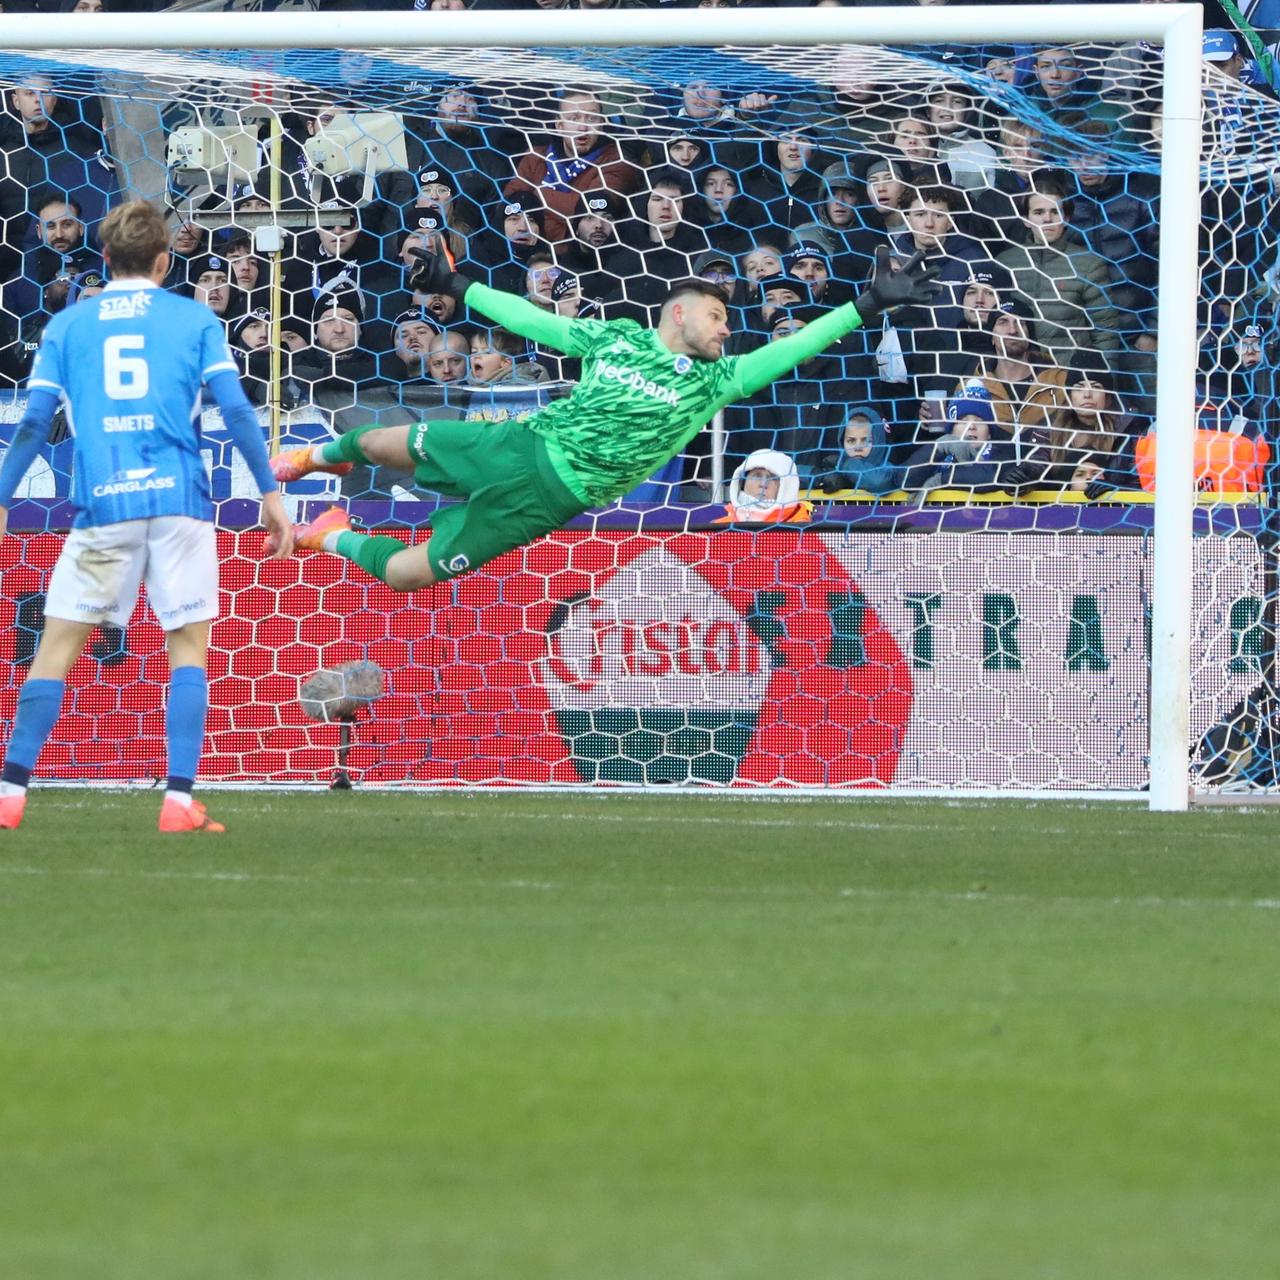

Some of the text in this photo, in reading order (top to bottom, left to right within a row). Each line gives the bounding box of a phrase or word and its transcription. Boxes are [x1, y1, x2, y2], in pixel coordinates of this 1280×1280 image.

[99, 293, 149, 314] STAR
[103, 335, 150, 401] 6
[103, 415, 155, 433] SMETS
[93, 475, 176, 498] CARGLASS
